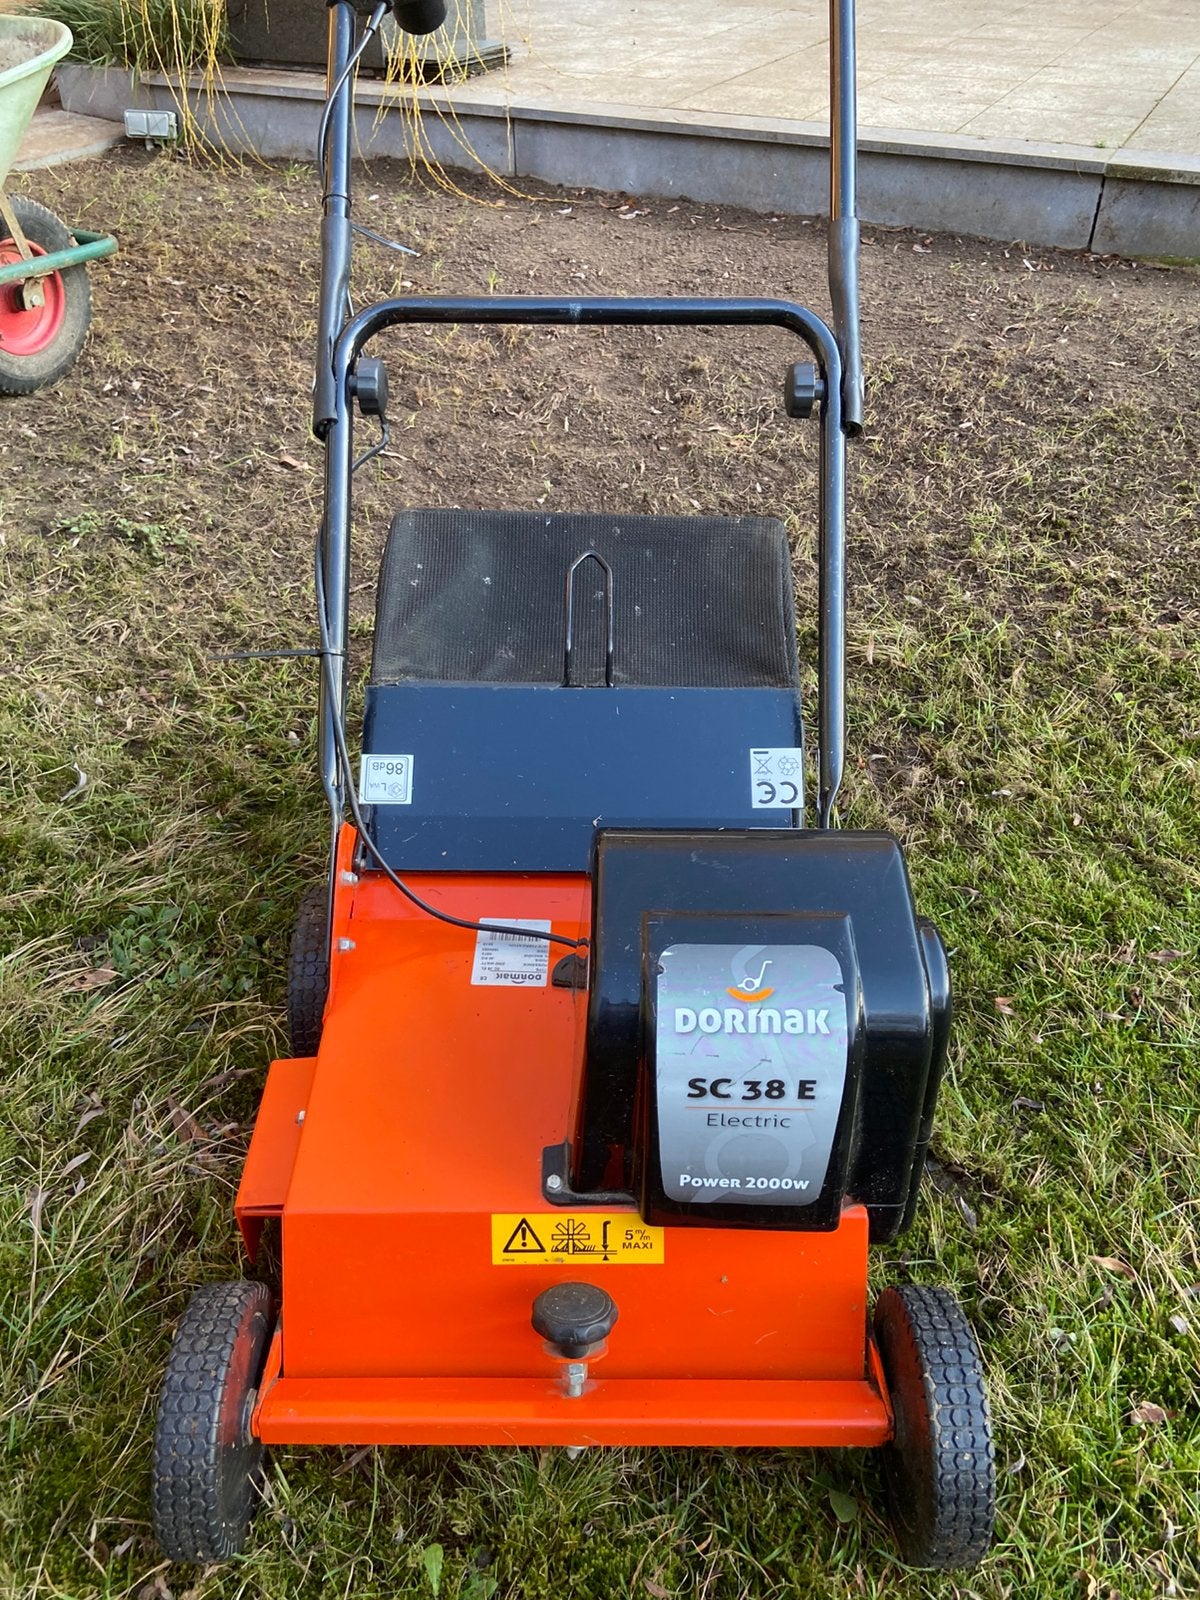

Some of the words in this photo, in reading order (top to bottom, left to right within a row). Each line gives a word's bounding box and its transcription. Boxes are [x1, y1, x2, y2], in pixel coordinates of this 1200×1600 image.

[687, 1078, 732, 1100] SC
[741, 1079, 786, 1101] 38
[797, 1079, 817, 1100] E
[706, 1113, 792, 1129] Electric
[679, 1174, 741, 1188] Power
[625, 1229, 634, 1241] 5
[622, 1242, 653, 1250] MAXI
